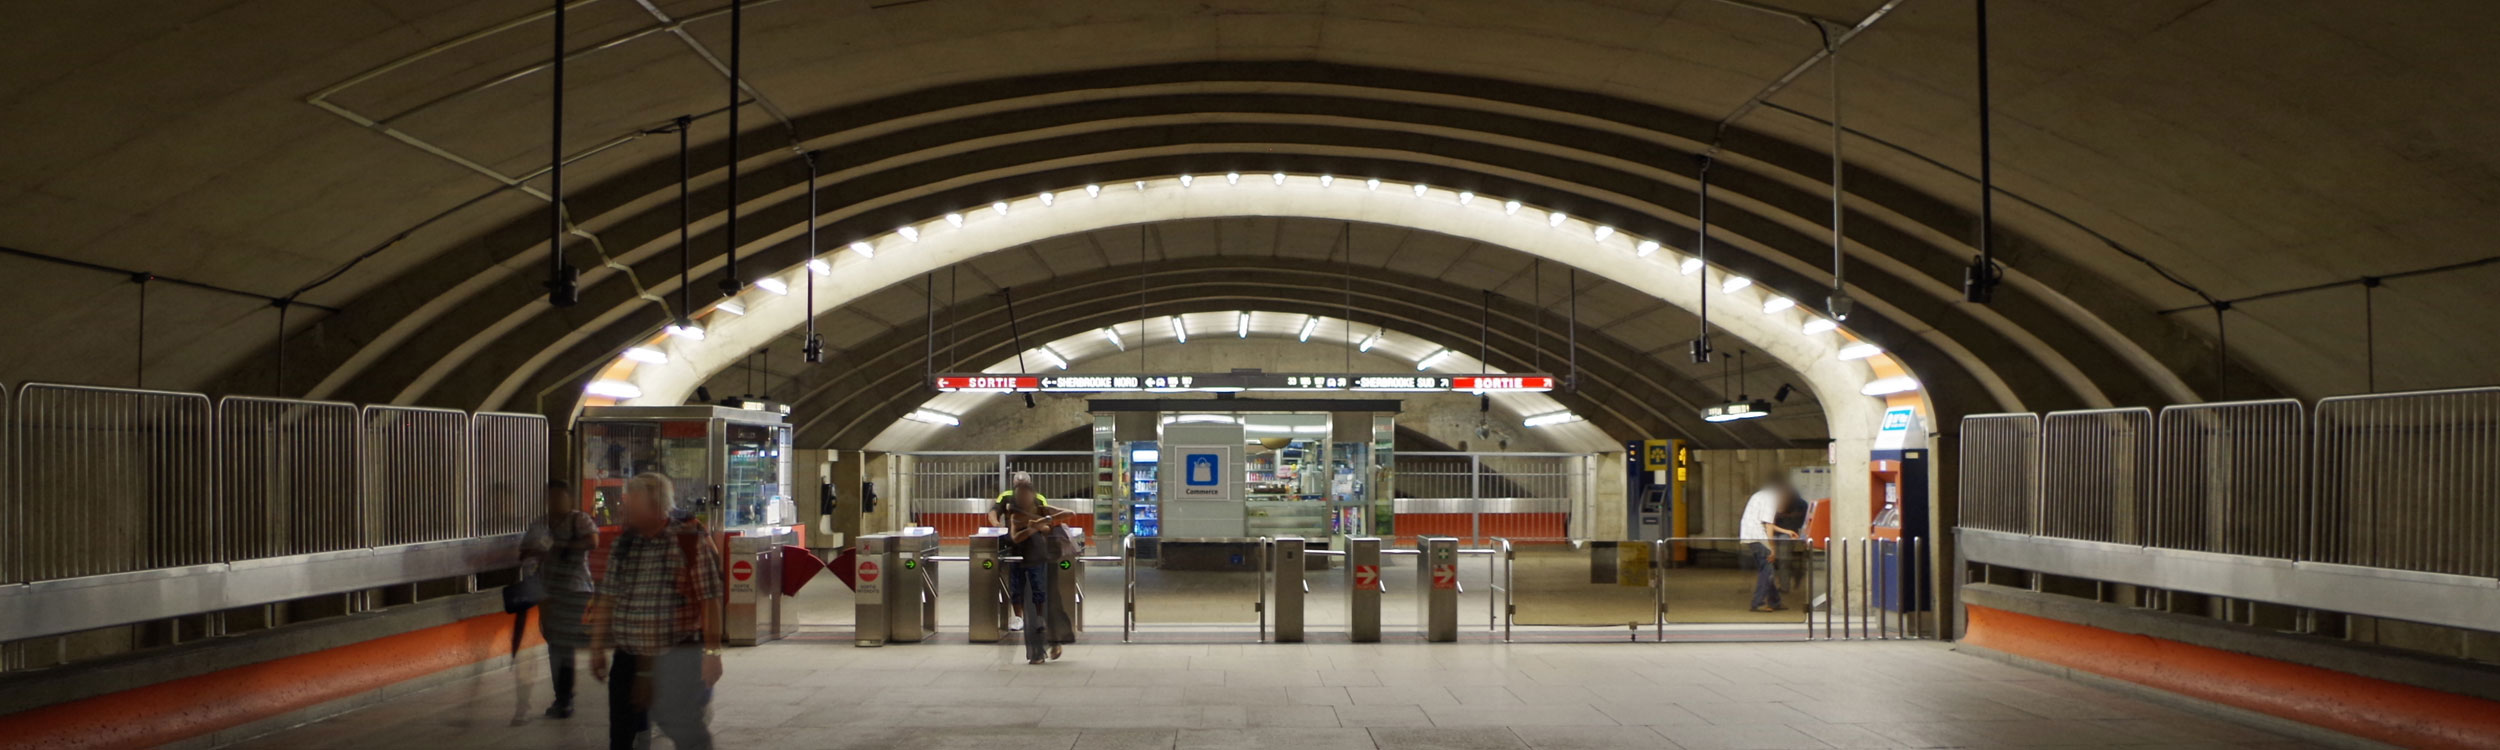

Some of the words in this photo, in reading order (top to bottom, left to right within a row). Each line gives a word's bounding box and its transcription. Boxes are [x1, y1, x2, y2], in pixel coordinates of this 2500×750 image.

[969, 377, 1016, 388] SORTIE
[1057, 377, 1112, 388] SHERBROOKE
[1113, 377, 1138, 388] NORD
[1360, 377, 1415, 388] SHERBROOKE
[1417, 377, 1435, 388] SUD
[1474, 377, 1523, 388] SORTIE
